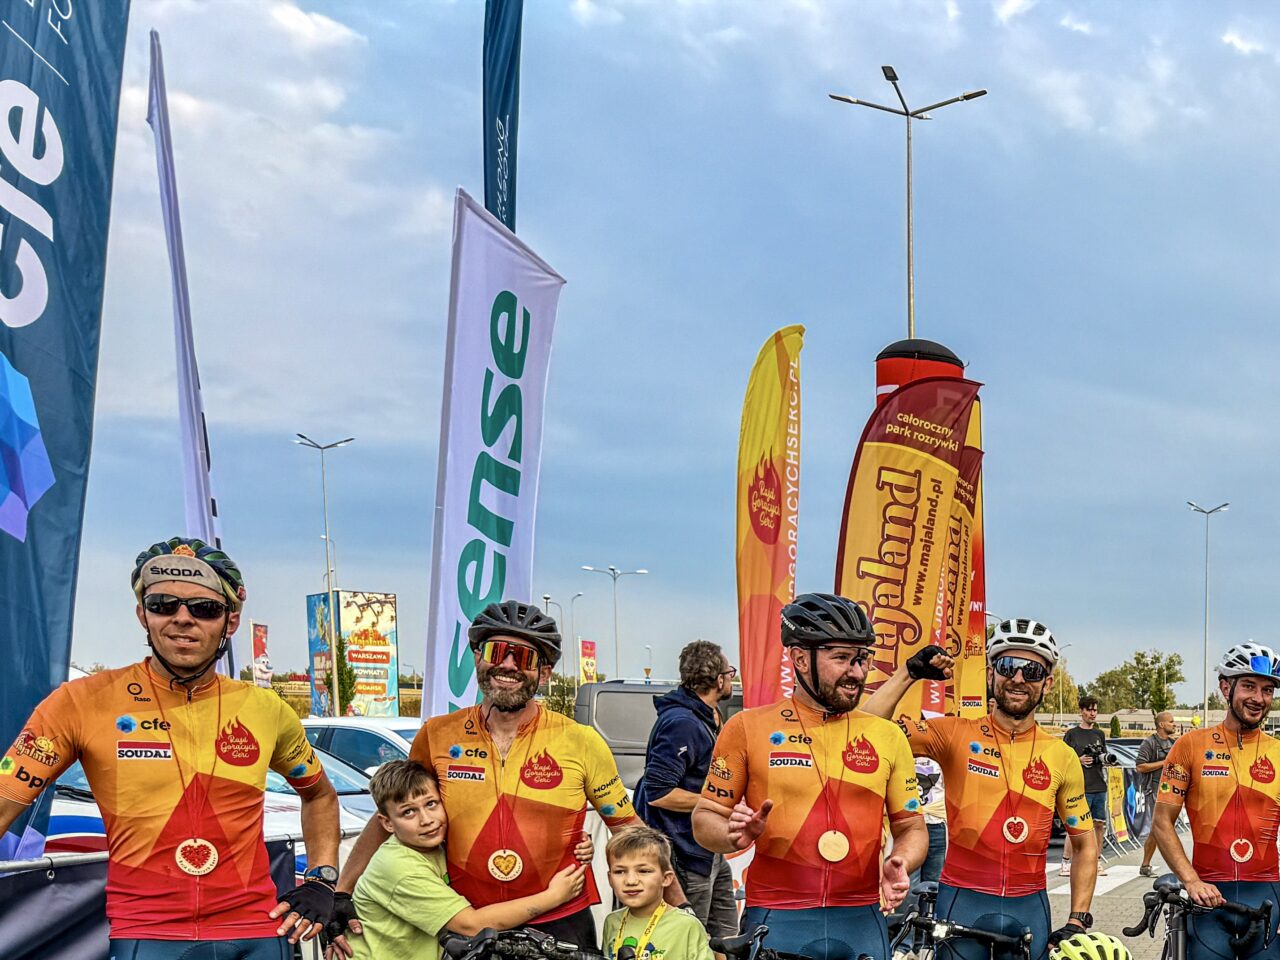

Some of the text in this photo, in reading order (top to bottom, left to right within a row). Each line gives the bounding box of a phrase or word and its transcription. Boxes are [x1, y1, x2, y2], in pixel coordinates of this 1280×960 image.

[0, 80, 64, 328] cfe
[896, 412, 954, 438] całoroczny
[885, 423, 960, 452] park rozrywki
[912, 477, 943, 606] www.majaland.pl
[150, 565, 204, 578] ŠKODA
[351, 652, 387, 660] WARSZAWA
[140, 718, 171, 731] cfe
[228, 734, 248, 744] Rajd
[788, 734, 813, 745] cfe
[118, 749, 172, 759] SOUDAL
[464, 747, 488, 759] cfe
[982, 745, 1001, 758] cfe
[1215, 753, 1231, 761] cfe
[769, 758, 811, 767] SOUDAL
[447, 771, 485, 781] SOUDAL
[967, 763, 999, 778] SOUDAL
[706, 781, 735, 800] bpi
[1171, 784, 1187, 798] bp
